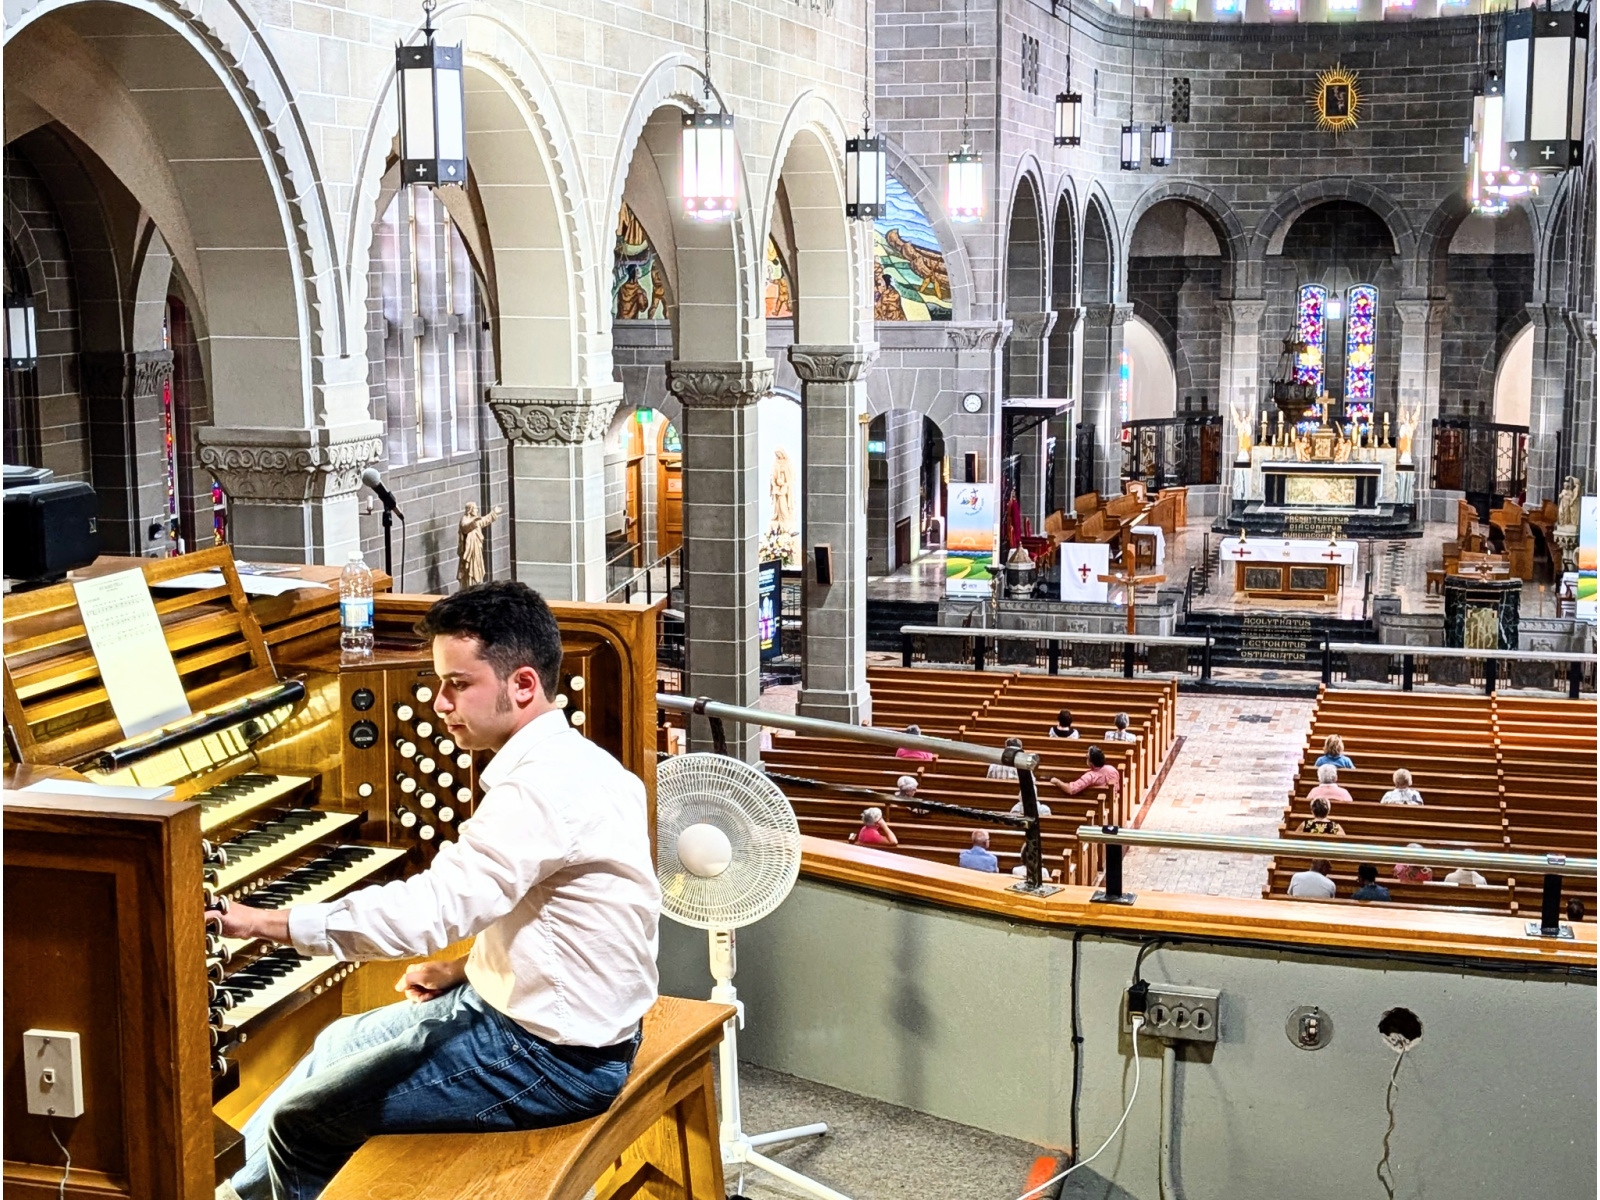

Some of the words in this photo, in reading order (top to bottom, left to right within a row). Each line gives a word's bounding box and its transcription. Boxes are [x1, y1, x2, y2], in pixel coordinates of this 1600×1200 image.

[1243, 617, 1311, 626] ACOLYTHATUS
[1242, 639, 1307, 648] LECTORATUS
[1240, 651, 1306, 660] OSTIARIATUS
